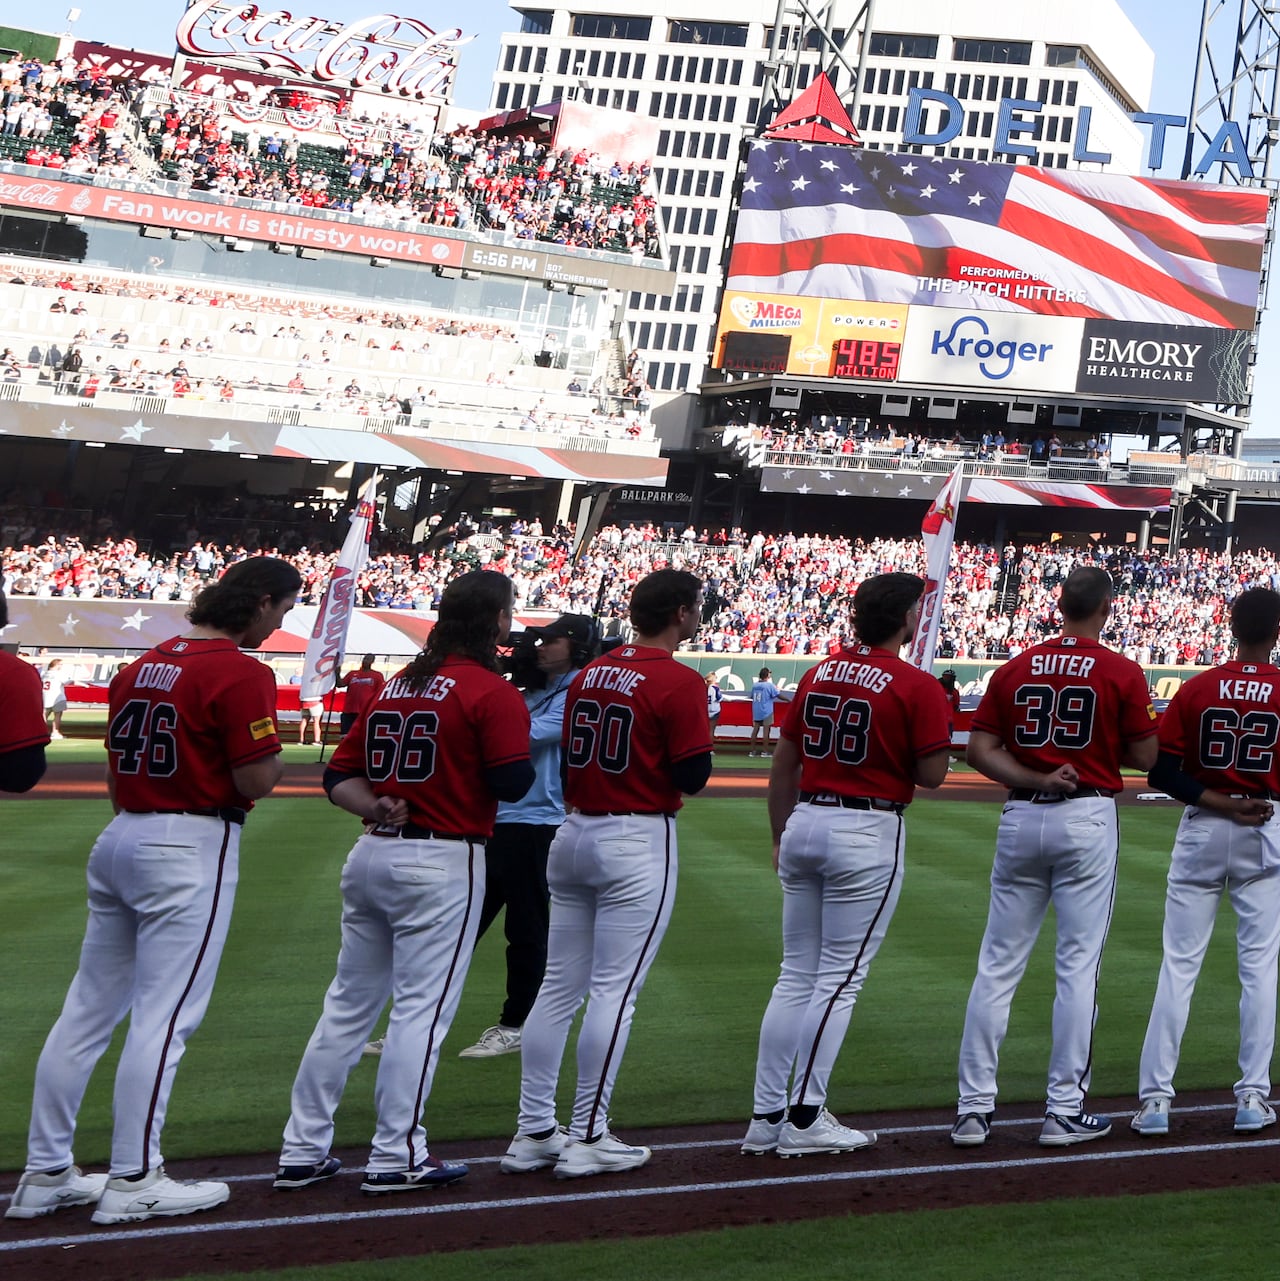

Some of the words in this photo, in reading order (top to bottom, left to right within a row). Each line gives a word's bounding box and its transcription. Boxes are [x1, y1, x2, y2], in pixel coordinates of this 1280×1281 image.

[903, 88, 1254, 178] DELTA
[102, 196, 154, 219] Fan
[162, 209, 233, 229] work
[239, 214, 260, 233] is
[267, 218, 355, 251] thirsty
[360, 233, 422, 257] work
[472, 250, 508, 268] 5:56
[511, 256, 537, 272] PM
[960, 265, 1029, 281] PERFORMED
[917, 276, 952, 294] THE
[956, 280, 1010, 299] PITCH
[1015, 285, 1088, 304] HITTERS
[754, 301, 801, 320] MEGA
[835, 316, 886, 328] POWER
[839, 339, 901, 368] 485
[931, 316, 1053, 380] Kroger
[1088, 336, 1202, 368] EMORY
[836, 364, 895, 379] MILLION
[1087, 366, 1193, 382] HEALTHCARE
[621, 489, 674, 502] BALLPARK
[135, 662, 182, 693] DODD
[581, 665, 647, 697] RITCHIE
[812, 659, 893, 694] MEDEROS
[1031, 654, 1096, 678] SUTER
[1219, 679, 1273, 704] KERR
[802, 692, 872, 766] 58
[1014, 683, 1097, 750] 39
[109, 699, 178, 778] 46
[365, 710, 439, 783] 66
[567, 698, 635, 774] 60
[1200, 707, 1280, 772] 62
